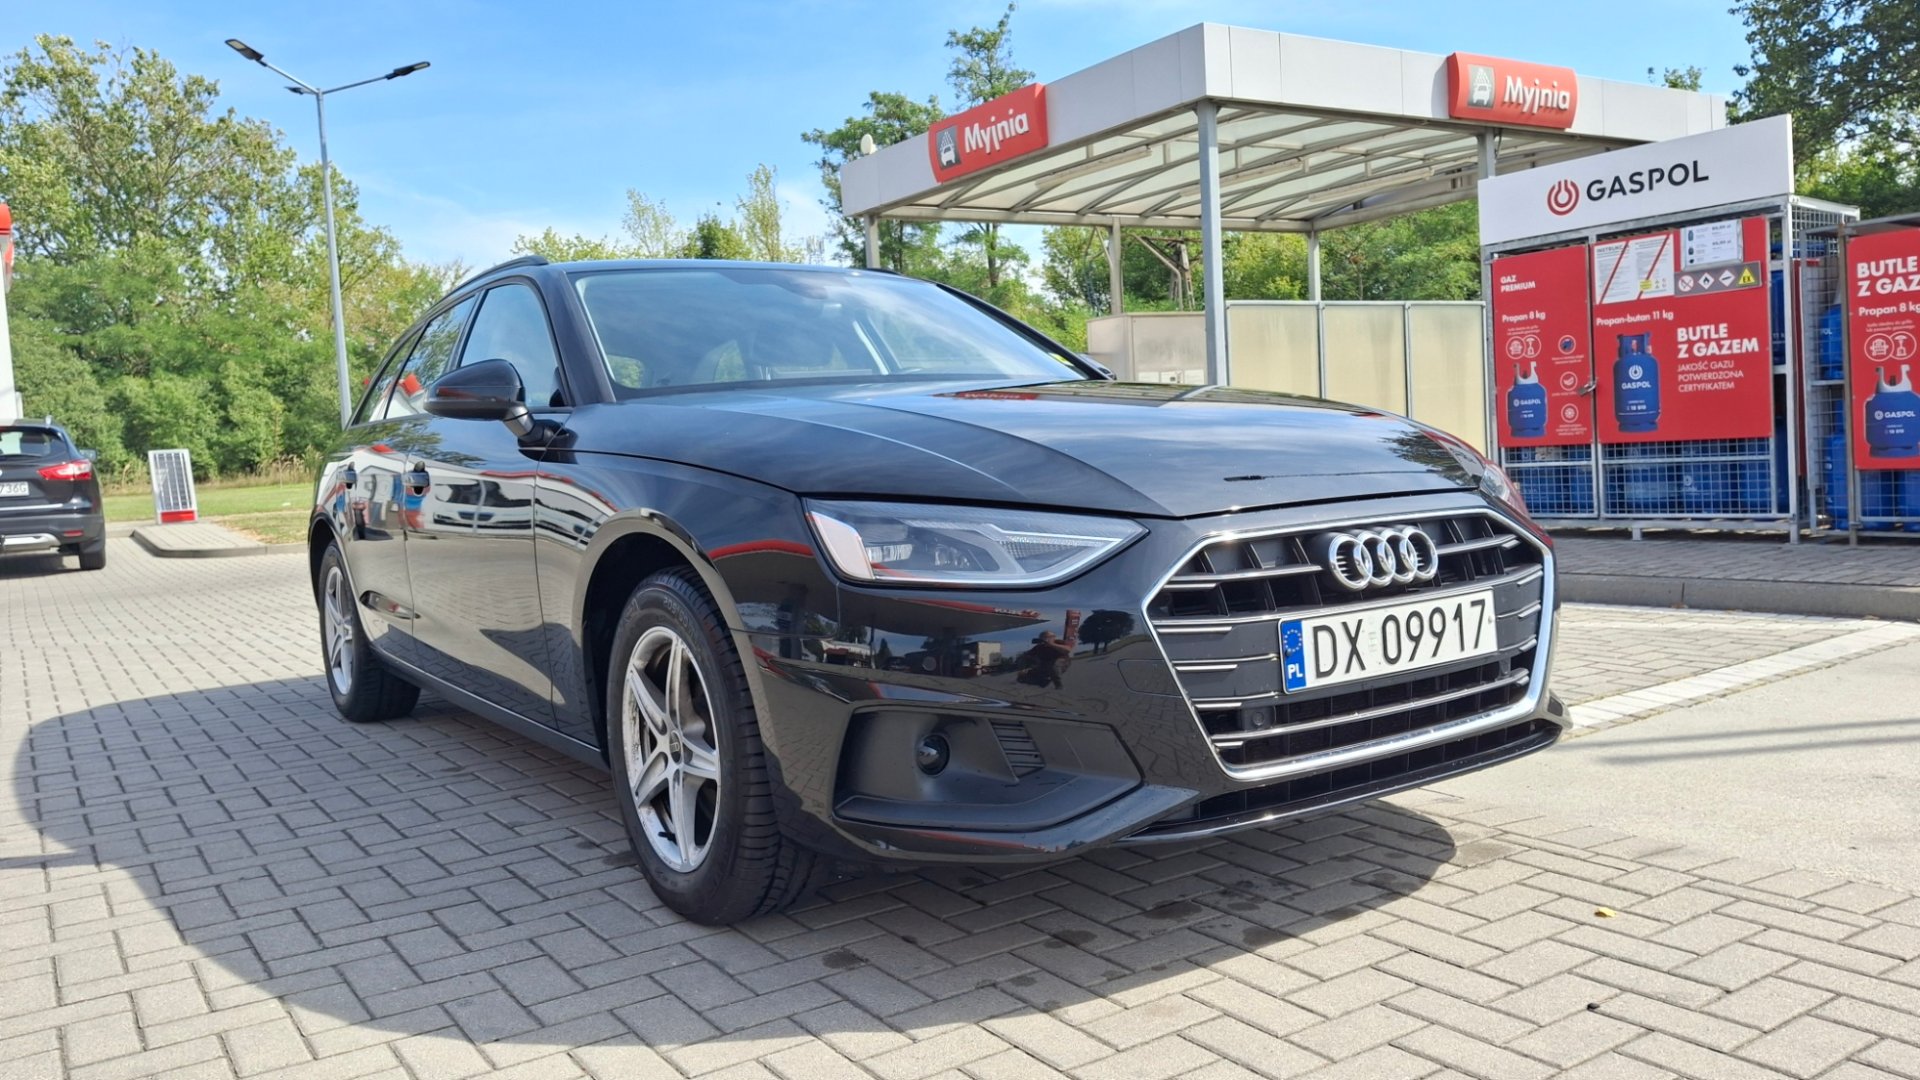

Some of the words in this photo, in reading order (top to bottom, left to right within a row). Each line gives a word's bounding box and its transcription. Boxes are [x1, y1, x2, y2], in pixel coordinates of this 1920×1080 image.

[1503, 75, 1571, 115] Myjnia
[964, 108, 1030, 154] Myjnia
[1586, 160, 1709, 201] GASPOL
[1857, 255, 1918, 278] BUTLE
[1500, 274, 1517, 284] GAZ
[1500, 281, 1536, 293] PREMIUM
[1857, 280, 1871, 297] Z
[1502, 313, 1528, 324] Propan
[1529, 310, 1535, 320] 8
[1535, 310, 1546, 321] kg
[1858, 304, 1897, 317] Propan
[1899, 302, 1907, 312] 8
[1596, 313, 1651, 327] Propan-butan
[1653, 310, 1660, 320] 11
[1662, 309, 1674, 321] kg
[1677, 323, 1728, 342] BUTLE
[1677, 343, 1689, 358] Z
[1693, 337, 1759, 357] GAZEM
[1677, 360, 1708, 372] JAKOŚĆ
[1710, 360, 1734, 370] GAZU
[1678, 369, 1744, 382] POTWIERDZONA
[1621, 381, 1651, 390] GASPOL
[1678, 381, 1735, 392] CERTYFIKATEM
[1884, 410, 1916, 419] GASPOL
[1313, 618, 1367, 679] DX
[1381, 599, 1486, 665] 09917
[1287, 664, 1303, 680] PL
